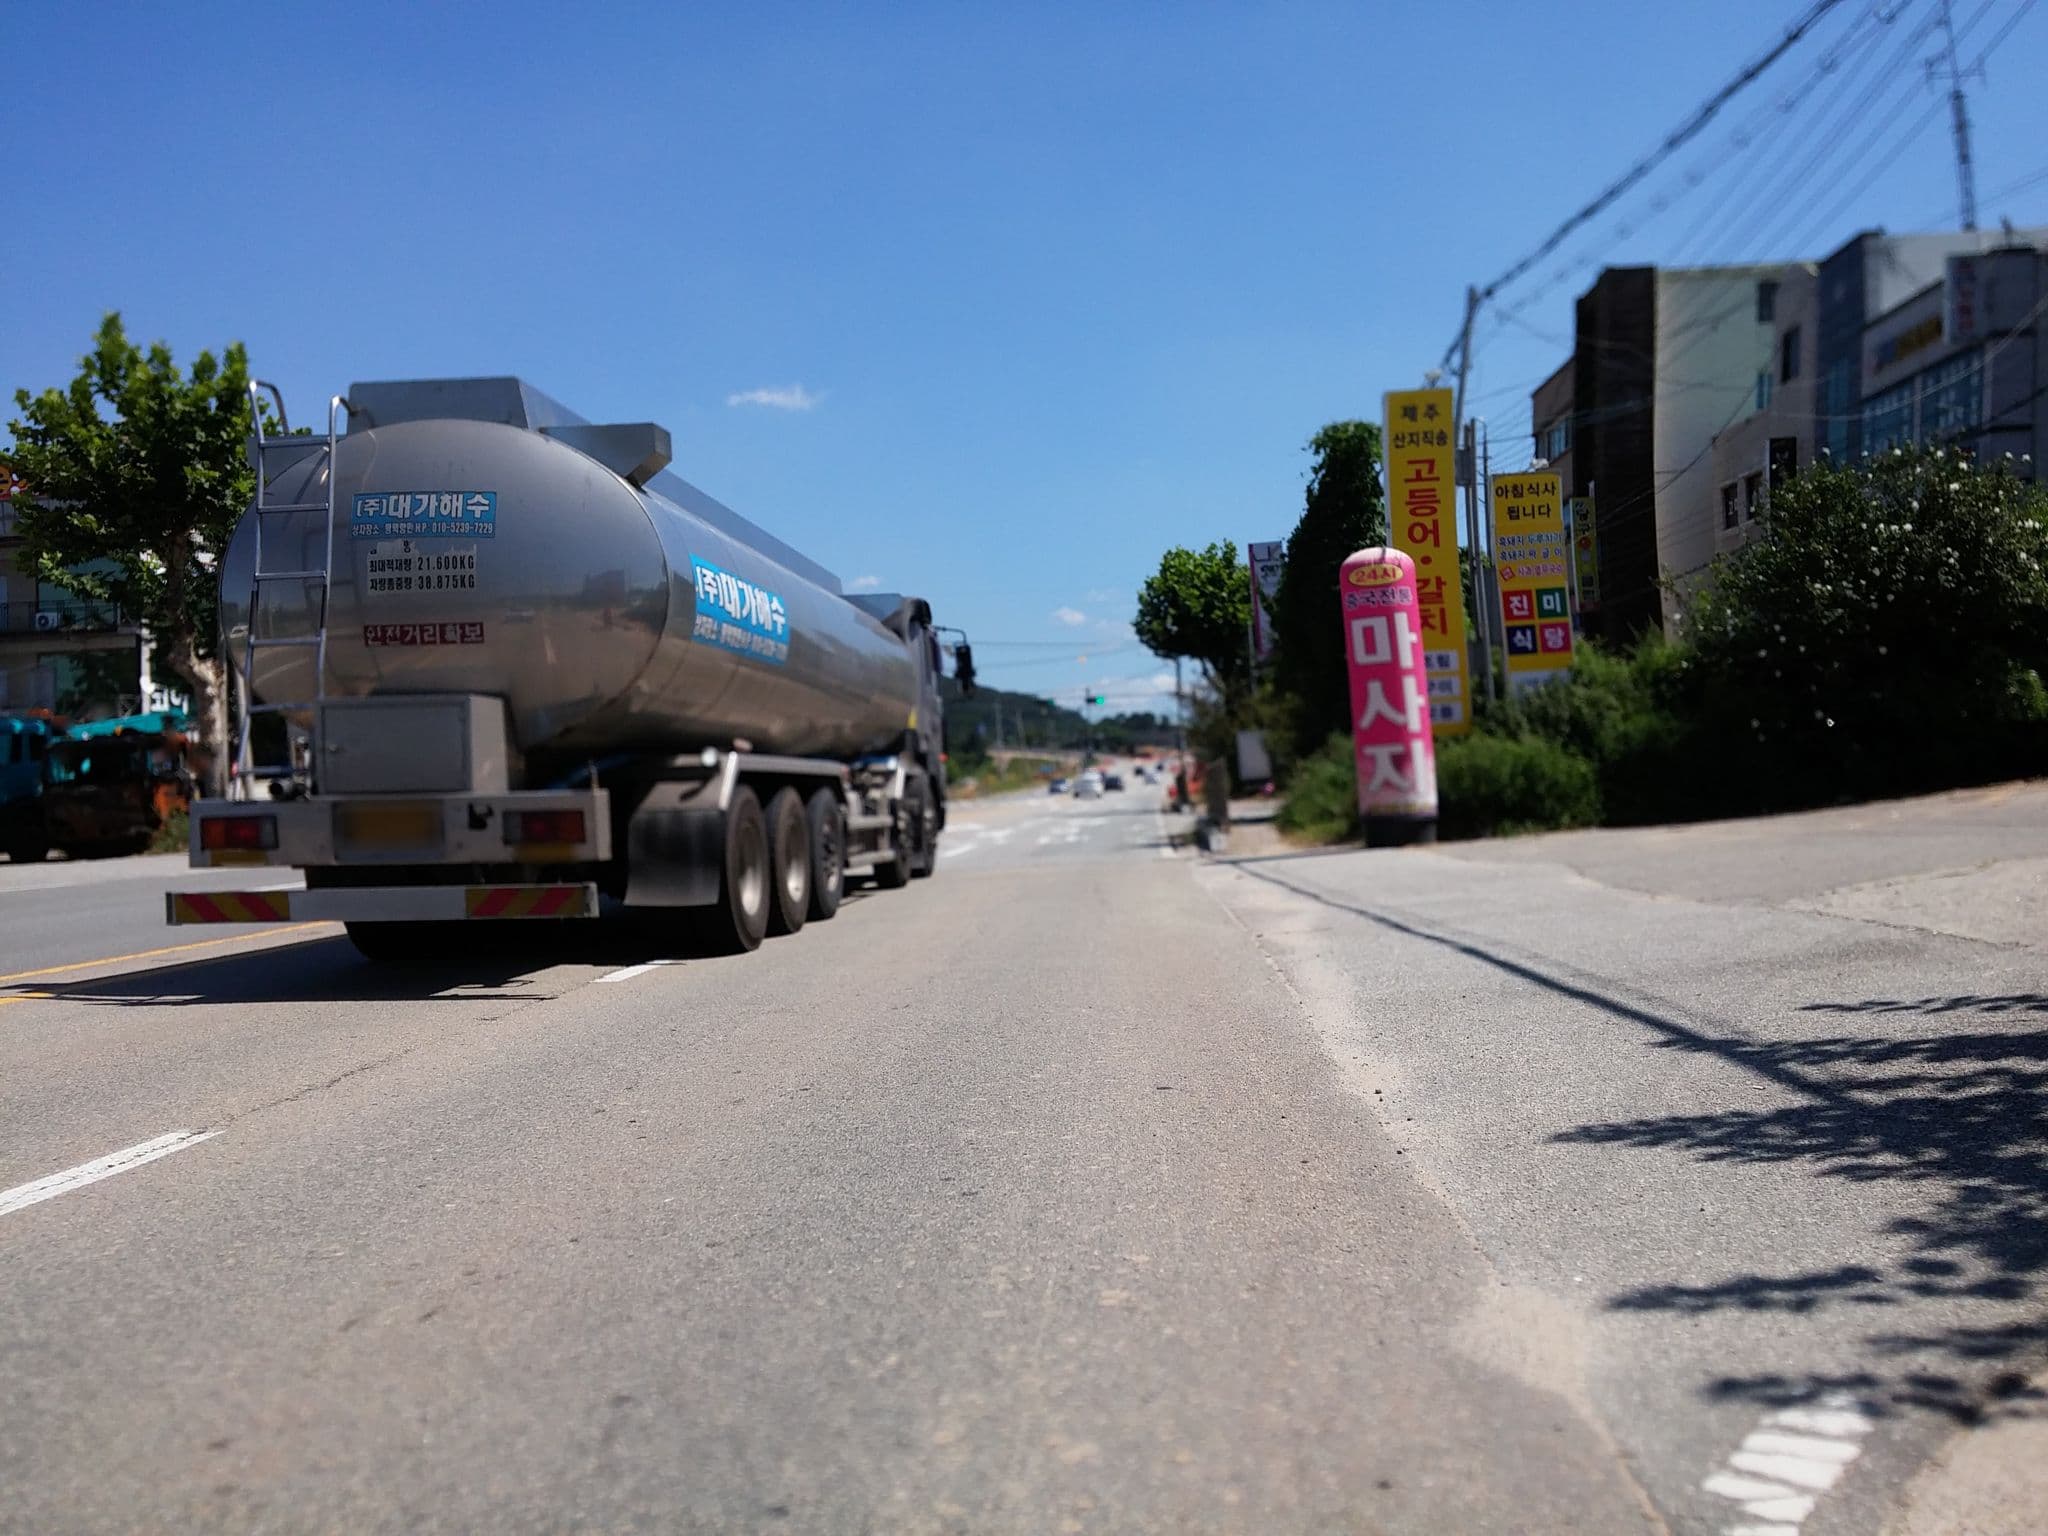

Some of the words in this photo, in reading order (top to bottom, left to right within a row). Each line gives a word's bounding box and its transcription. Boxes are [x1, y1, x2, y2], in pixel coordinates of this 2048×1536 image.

[1495, 481, 1556, 499] 아침식사
[1507, 503, 1551, 520] 됩니다
[369, 557, 412, 573] 최대적재량
[1355, 567, 1397, 582] 24시
[1351, 611, 1426, 793] 마사지
